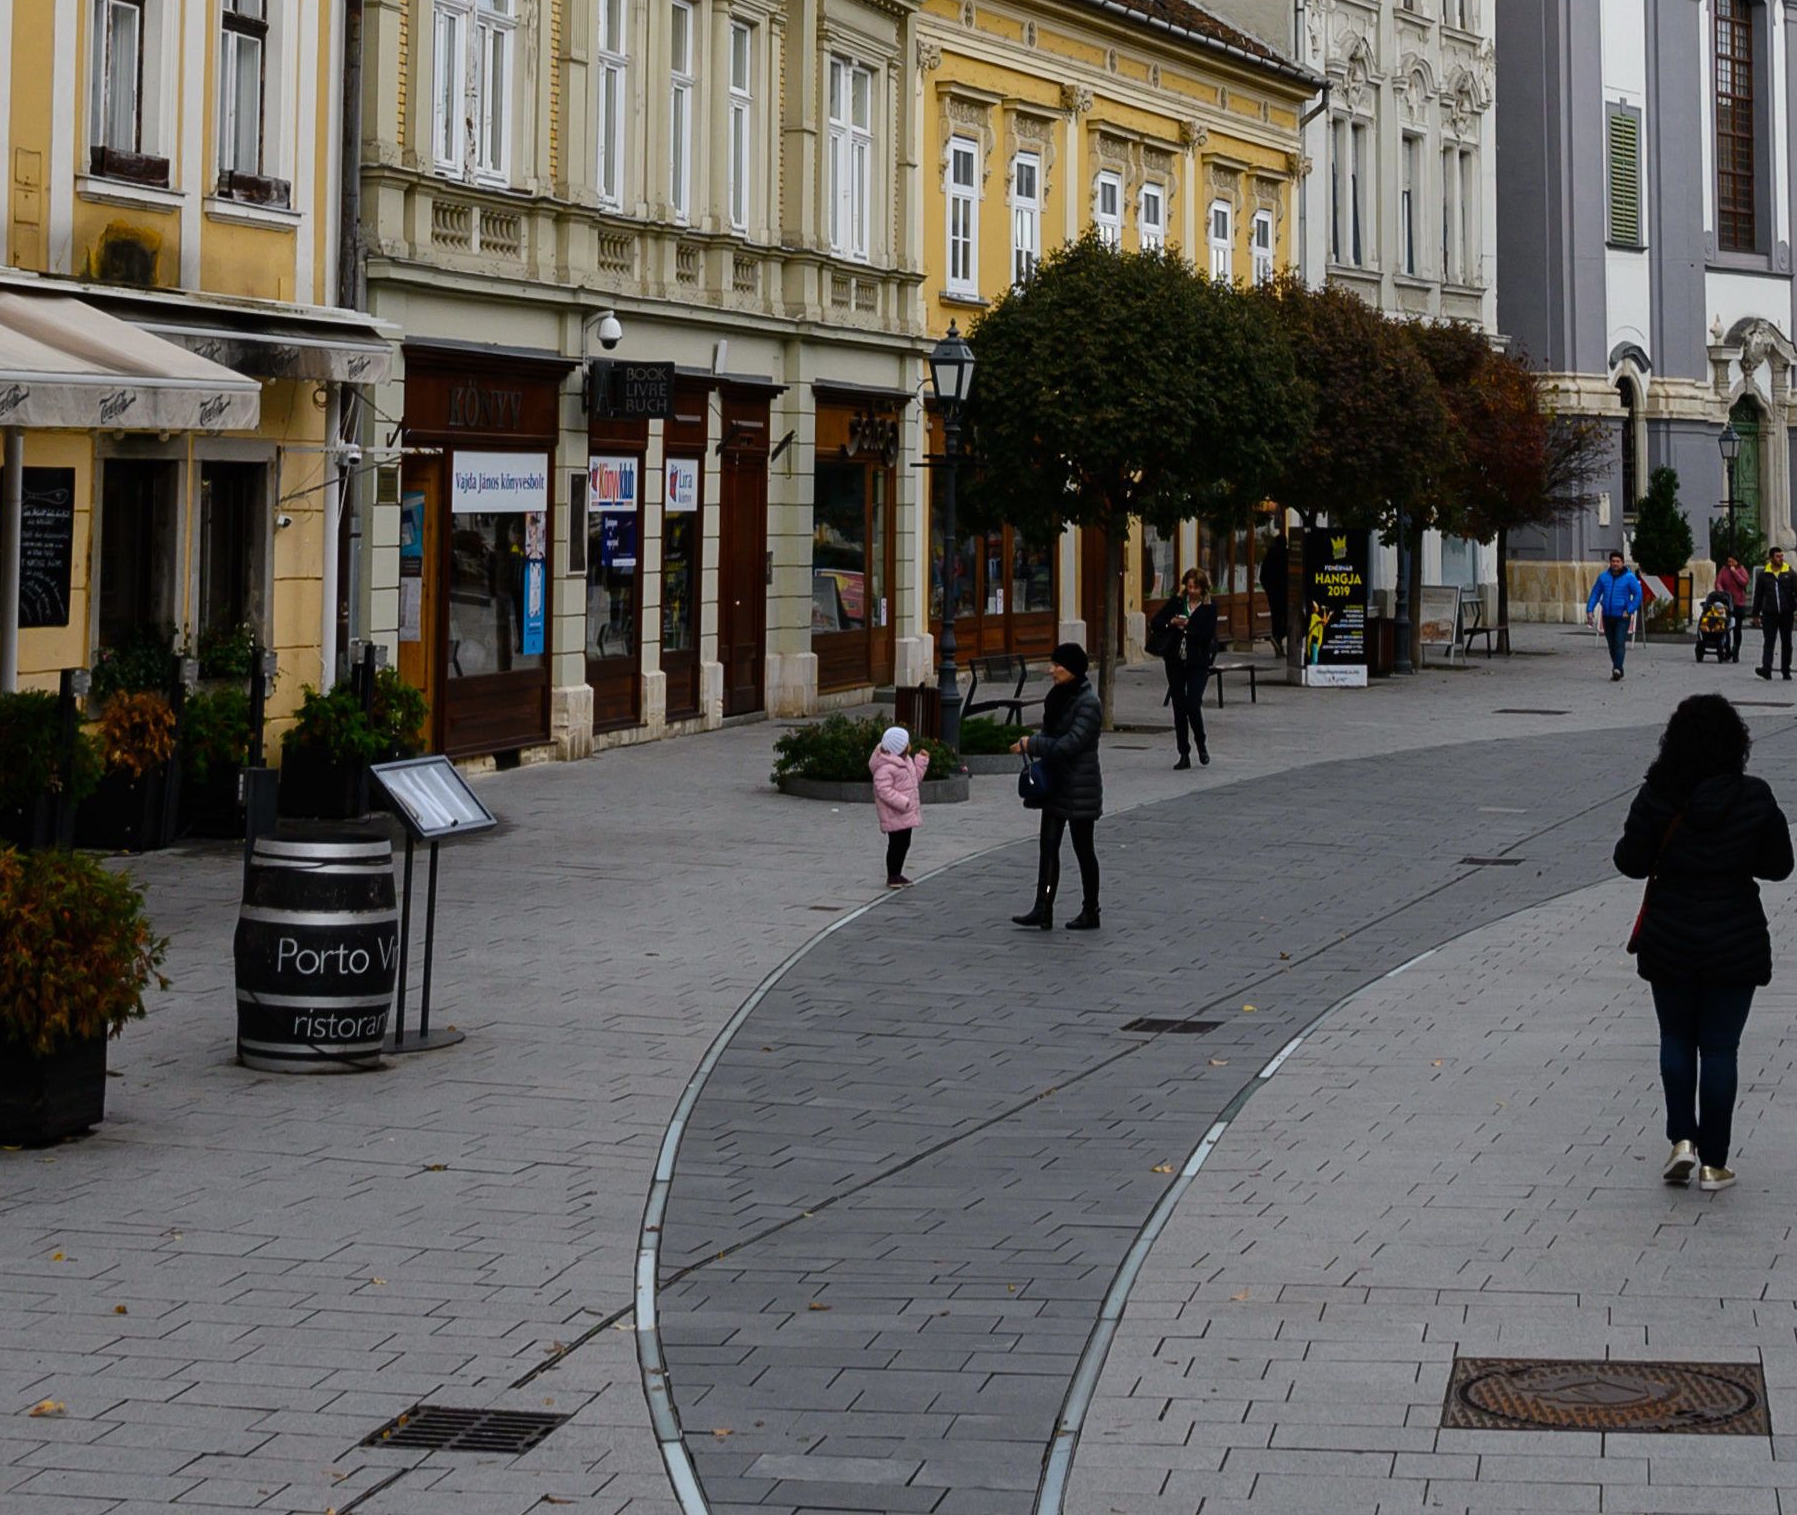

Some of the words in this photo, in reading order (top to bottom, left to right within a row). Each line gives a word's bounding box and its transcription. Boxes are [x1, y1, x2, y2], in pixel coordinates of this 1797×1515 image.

[626, 367, 667, 382] BOOK
[626, 383, 666, 397] LIVRE
[448, 377, 524, 429] KÖNYV
[626, 398, 667, 413] BUCH
[456, 473, 477, 494] Vajda
[478, 473, 500, 495] János
[501, 472, 545, 493] könyvesbolt
[1315, 572, 1362, 585] HANGJA
[1327, 586, 1351, 597] 2019
[277, 937, 370, 976] Porto
